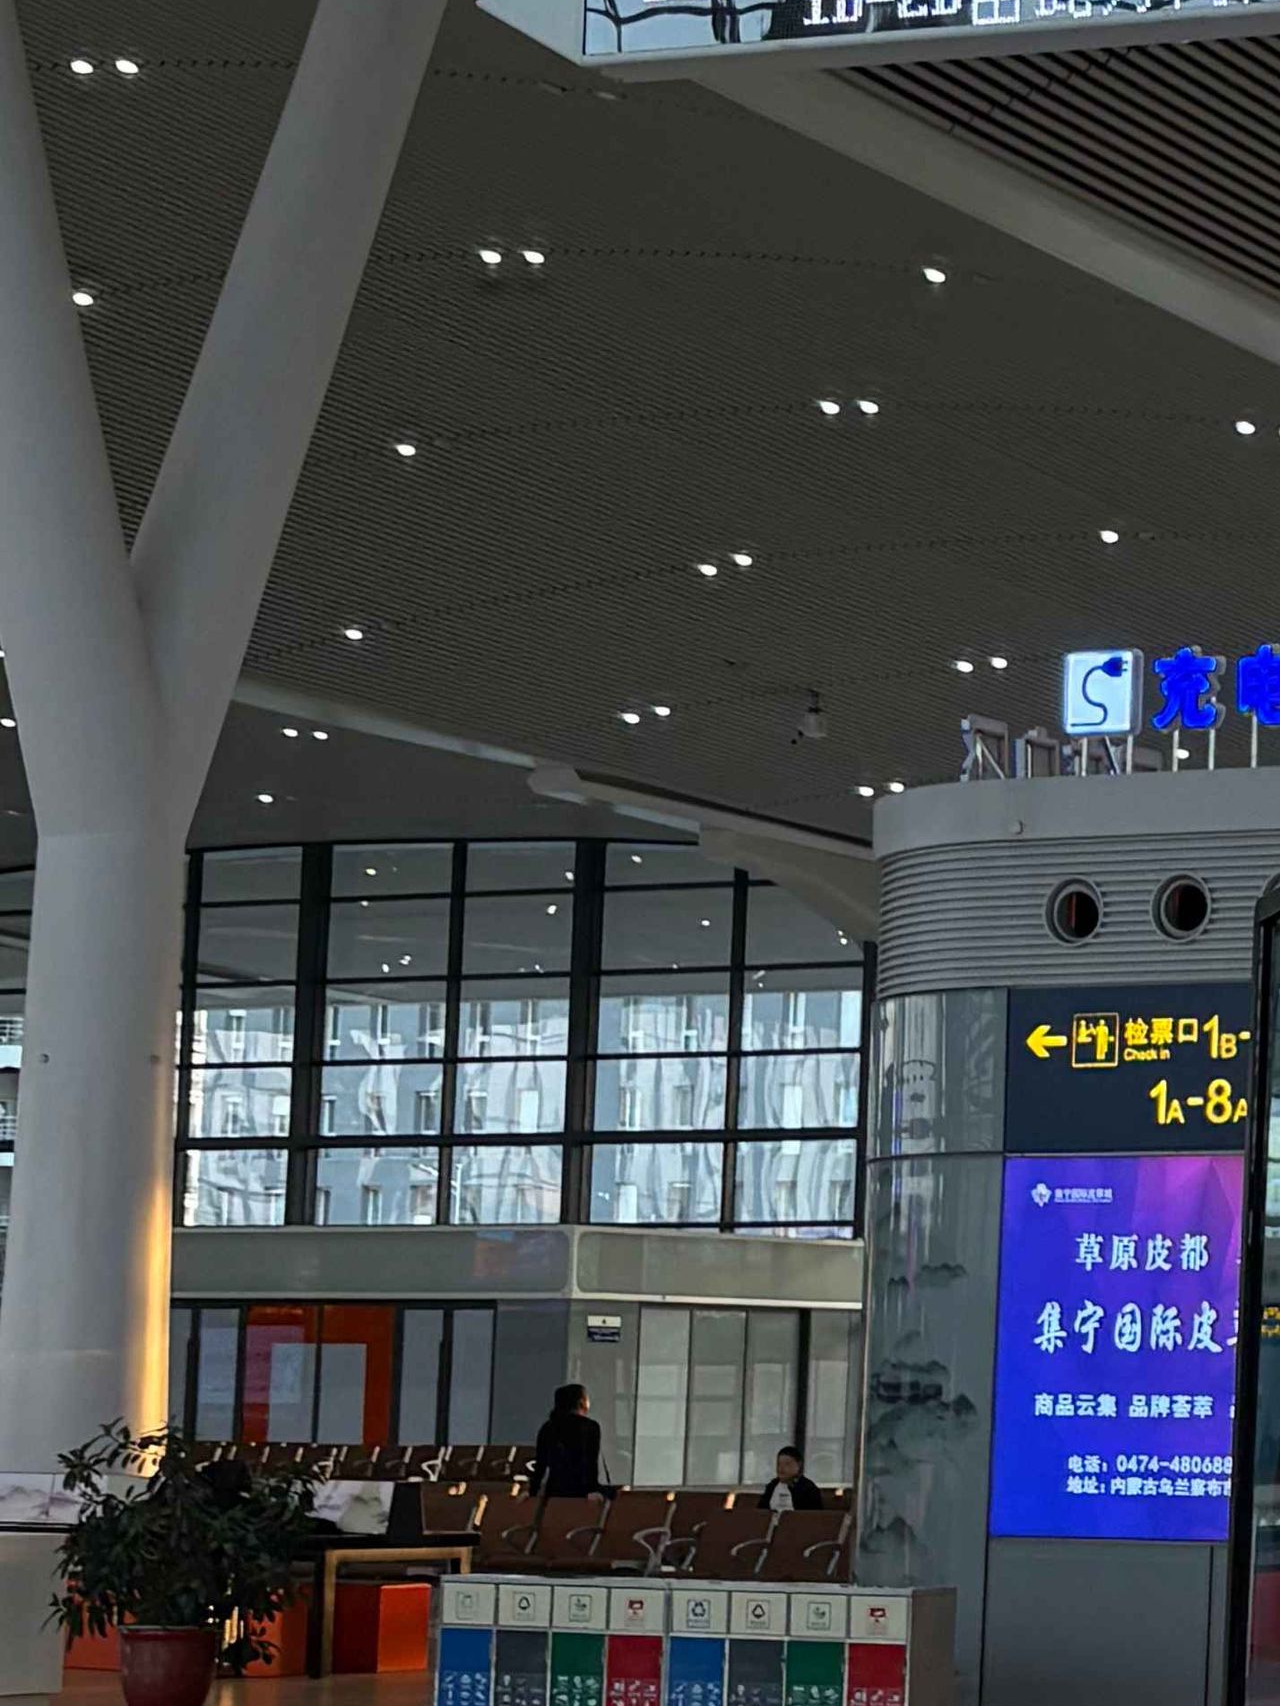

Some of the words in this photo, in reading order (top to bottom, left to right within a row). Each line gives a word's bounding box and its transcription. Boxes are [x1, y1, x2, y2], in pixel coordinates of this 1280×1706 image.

[1123, 1017, 1198, 1045] 检票口
[1074, 1233, 1210, 1271] 草原皮都
[1035, 1393, 1117, 1418] 商品云集
